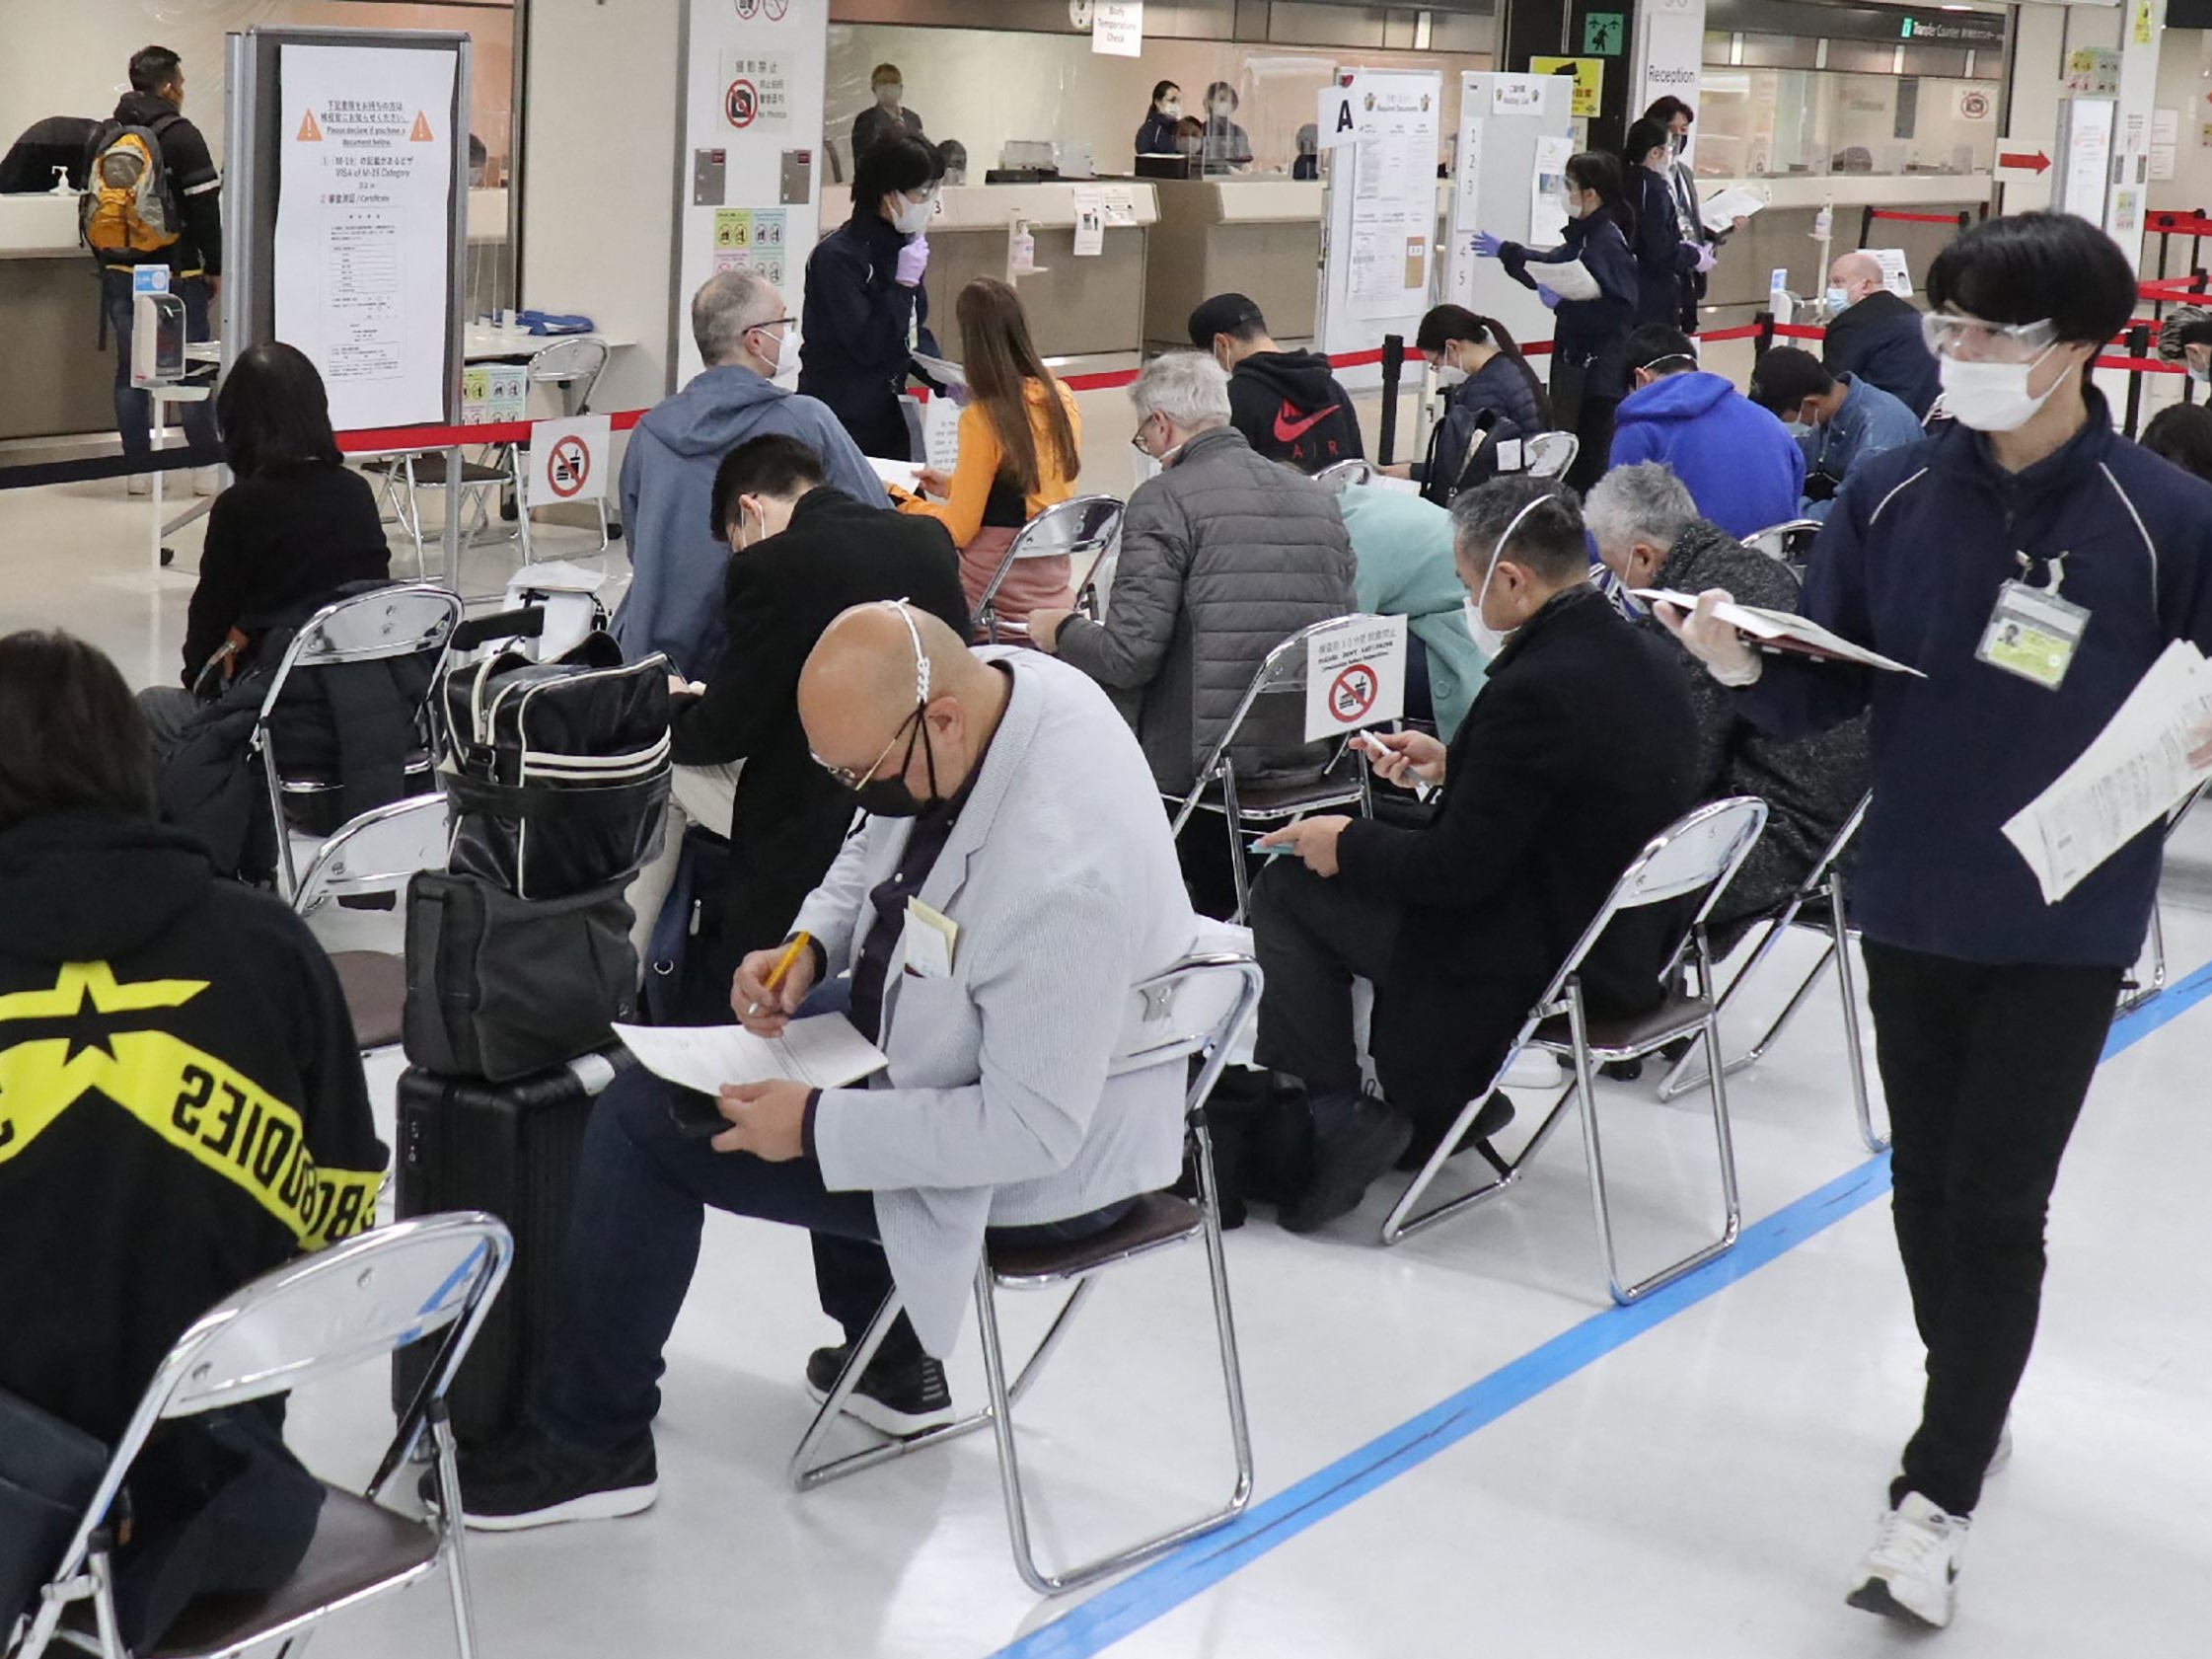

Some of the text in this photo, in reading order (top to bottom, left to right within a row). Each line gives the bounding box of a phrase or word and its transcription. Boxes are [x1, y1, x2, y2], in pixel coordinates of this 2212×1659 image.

[1109, 6, 1125, 18] Body
[1097, 18, 1137, 31] Temperature
[1106, 33, 1124, 42] Check
[735, 60, 777, 73] 撮影禁止
[1649, 65, 1695, 85] Reception
[1336, 99, 1354, 132] A
[1471, 129, 1476, 143] 1
[1469, 154, 1476, 168] 2
[381, 169, 410, 178] Category
[1467, 180, 1473, 195] 3
[1459, 246, 1466, 259] 4
[1459, 270, 1466, 286] 5
